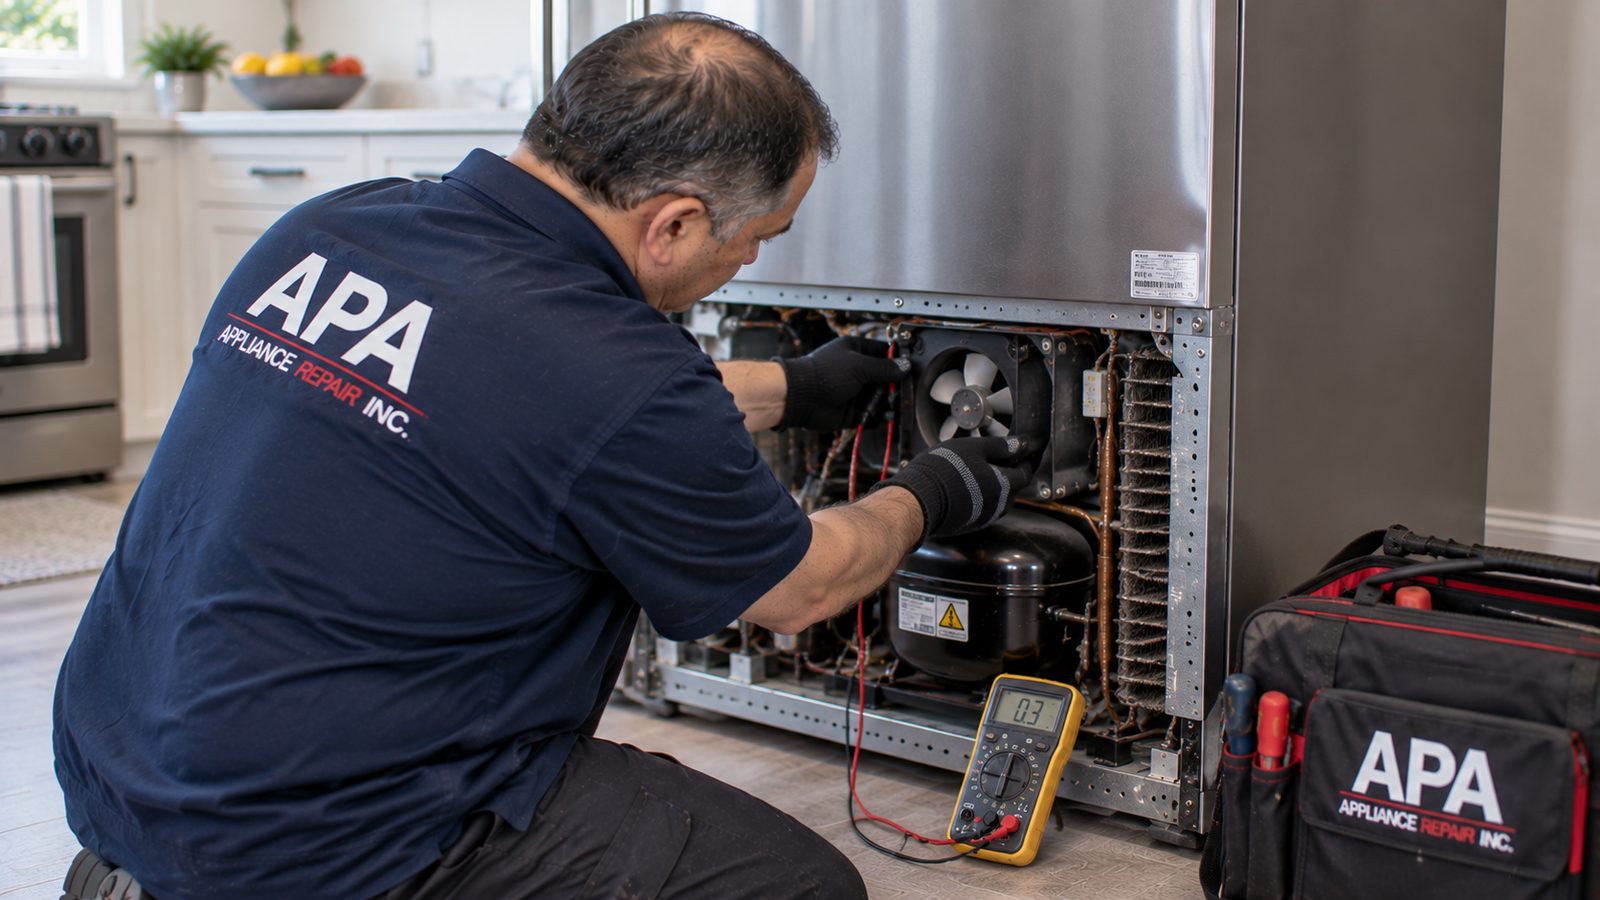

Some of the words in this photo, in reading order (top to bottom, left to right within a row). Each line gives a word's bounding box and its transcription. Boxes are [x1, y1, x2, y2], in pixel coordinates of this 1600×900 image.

[246, 252, 433, 394] APA
[217, 324, 298, 372] APPLIANCE
[293, 360, 363, 407] REPAIR
[362, 396, 410, 439] INC.
[1013, 698, 1044, 726] 0.3
[1351, 730, 1503, 825] APA
[1338, 799, 1418, 832] APPLIANCE
[1419, 817, 1477, 844] REPAIR
[1478, 829, 1514, 853] INC.
